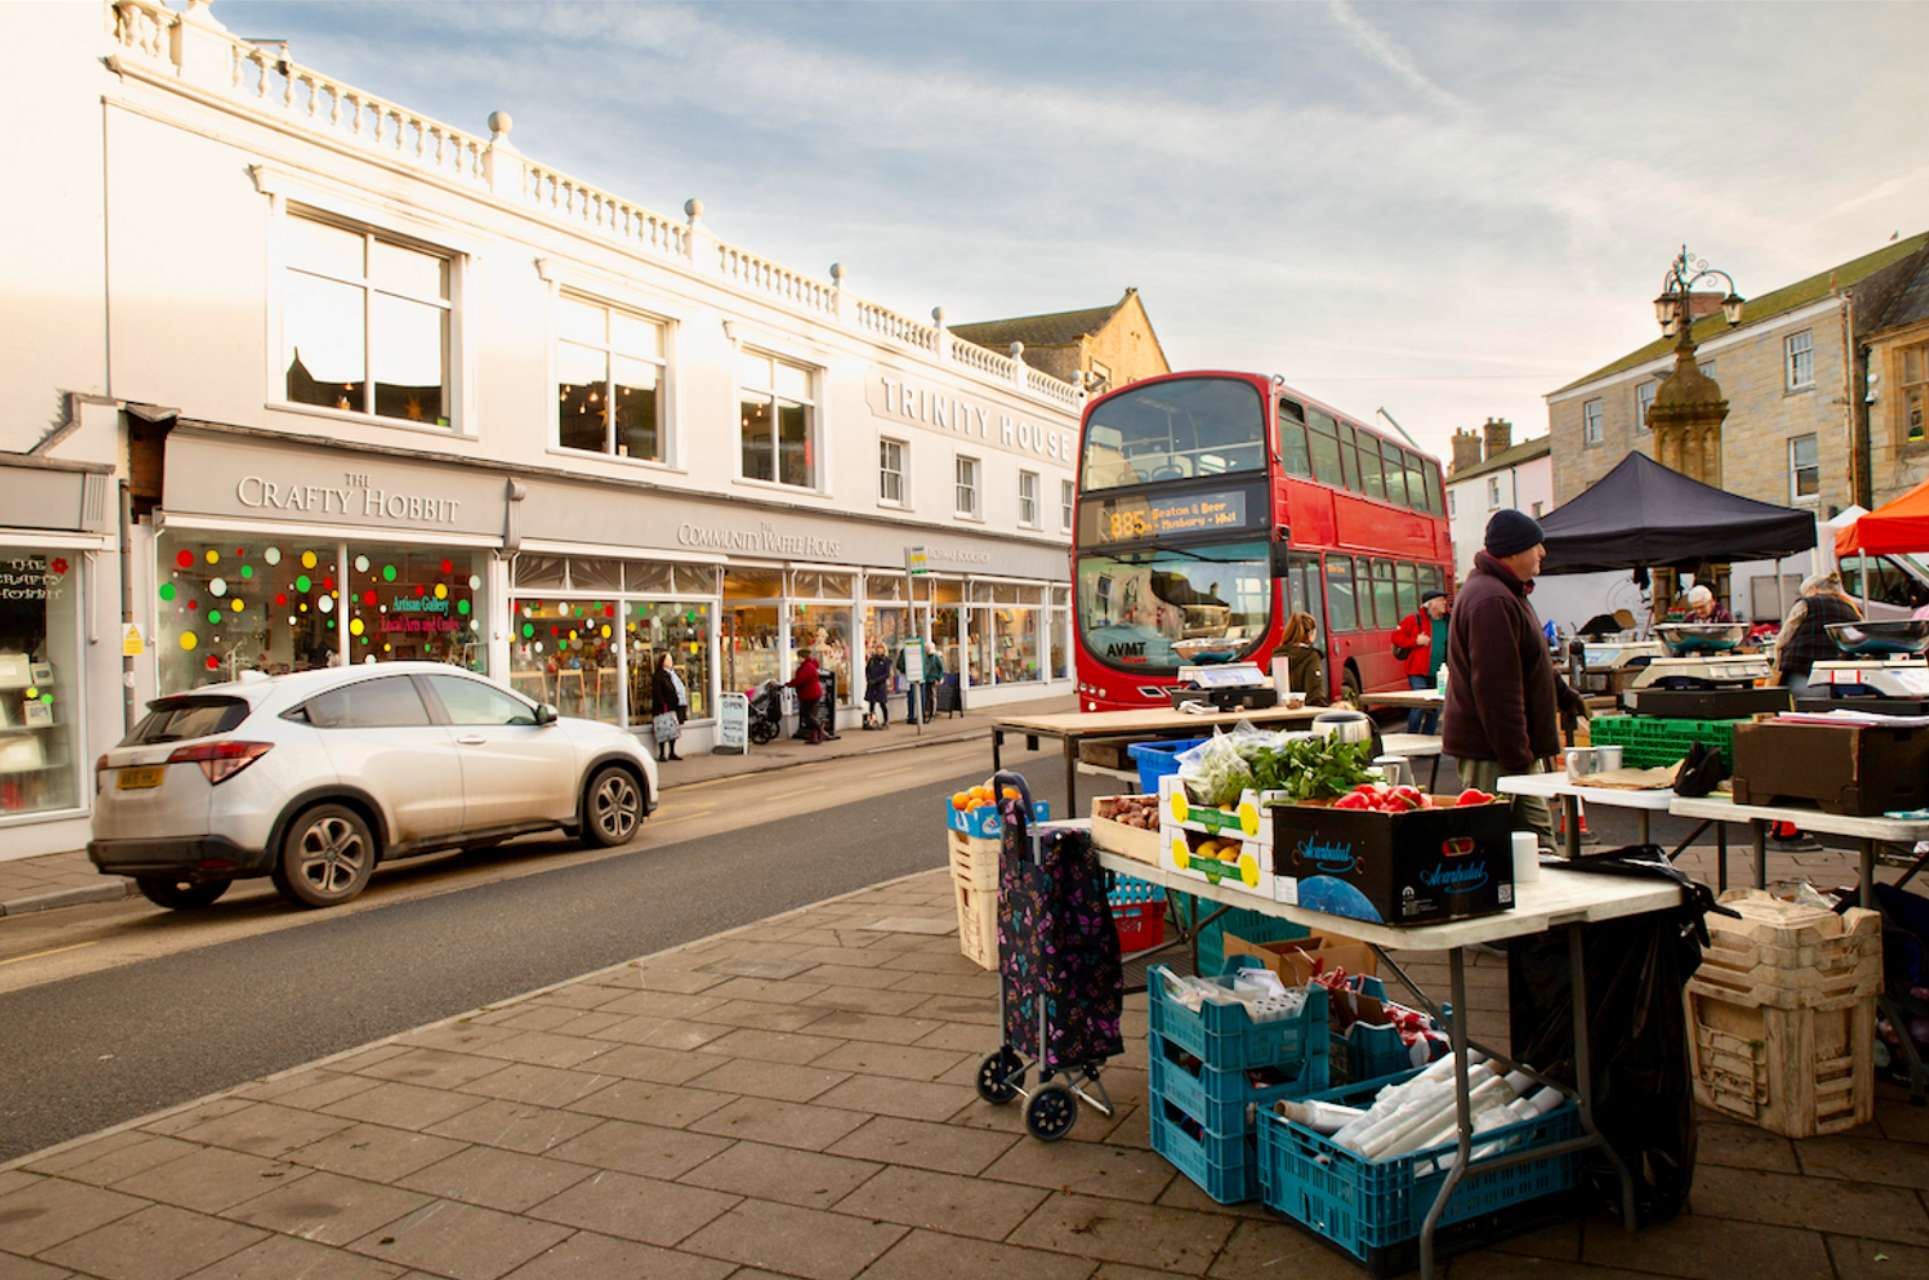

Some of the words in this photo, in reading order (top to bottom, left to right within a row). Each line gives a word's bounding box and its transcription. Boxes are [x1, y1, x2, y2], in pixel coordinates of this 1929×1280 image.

[881, 376, 991, 439] TRINITY
[1000, 415, 1071, 463] HOUSE
[344, 472, 370, 488] THE
[235, 475, 353, 514] CRAFTY
[363, 488, 461, 523] HOBBIT
[676, 522, 762, 551] COMMUNITY
[761, 532, 803, 554] WAFFLE
[804, 536, 840, 558] HOUSE
[393, 595, 420, 612] Artisan
[422, 595, 449, 617] Gallery
[1106, 642, 1146, 656] AVMT
